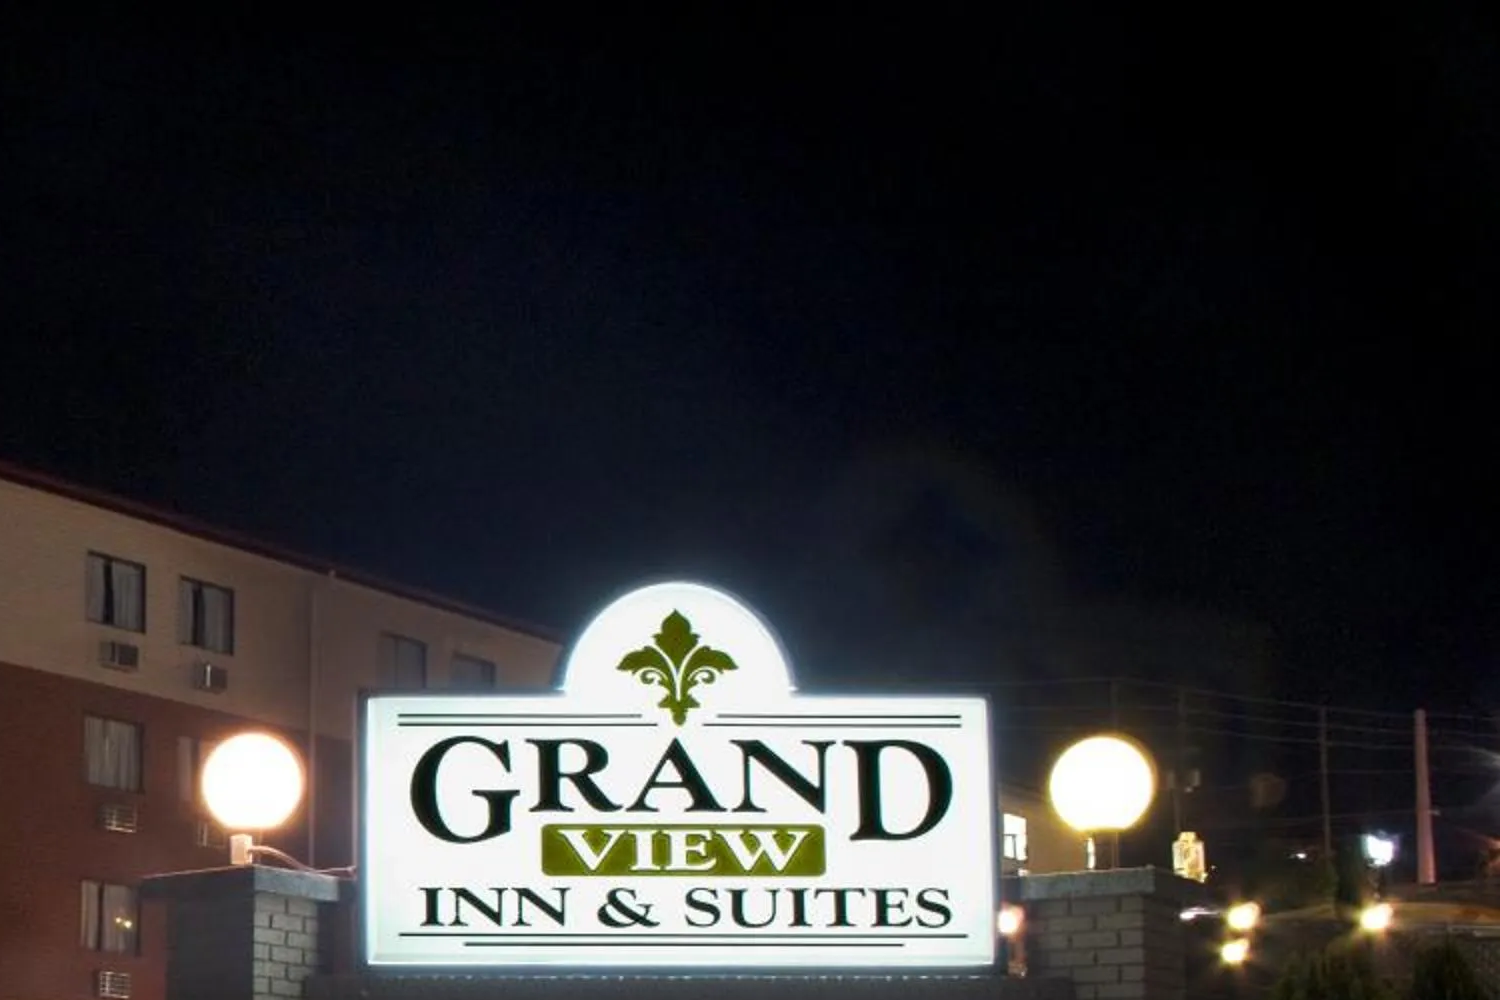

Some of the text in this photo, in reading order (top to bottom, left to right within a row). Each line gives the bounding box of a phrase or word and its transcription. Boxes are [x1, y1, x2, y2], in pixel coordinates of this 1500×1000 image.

[411, 735, 953, 845] GRAND
[559, 829, 809, 871] VIEW
[419, 887, 952, 929] INN & SUITES
